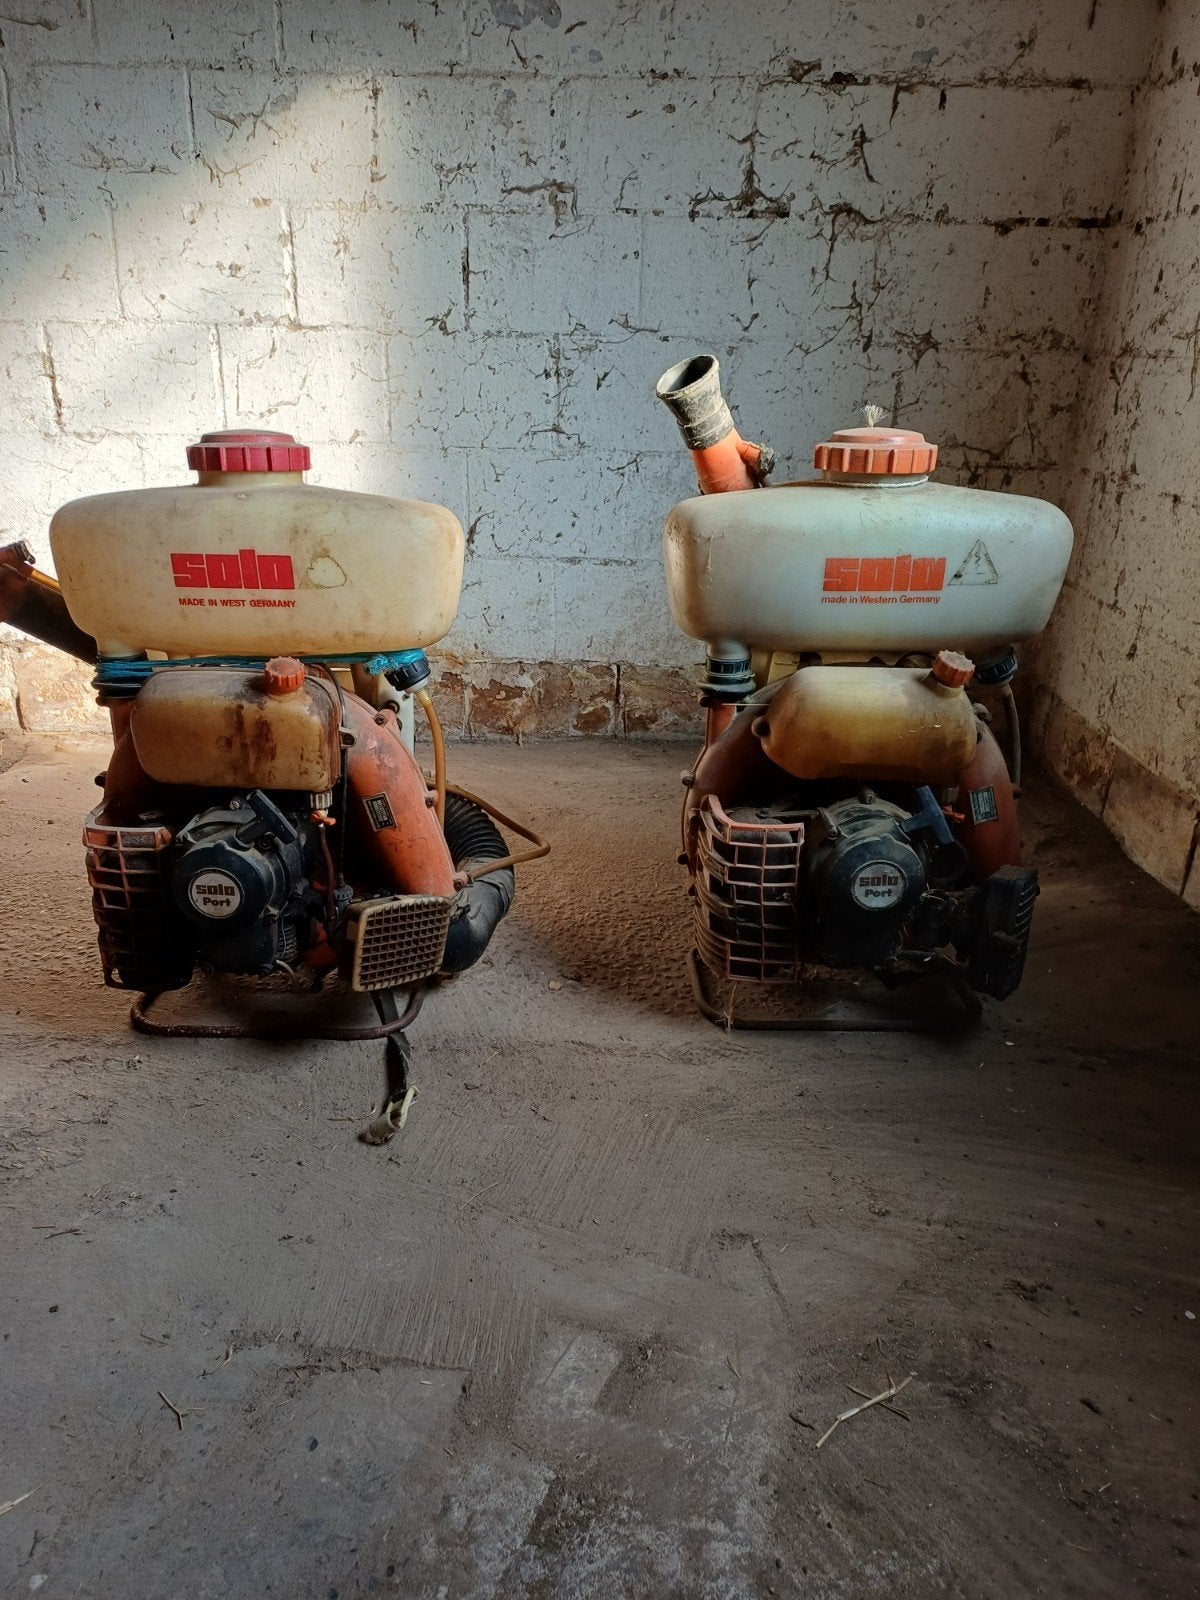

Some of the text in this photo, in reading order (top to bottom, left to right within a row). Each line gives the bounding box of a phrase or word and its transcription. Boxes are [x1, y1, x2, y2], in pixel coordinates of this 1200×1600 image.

[170, 549, 295, 590] solo
[178, 598, 296, 608] MADE IN WEST GERMANY
[821, 595, 941, 605] made in Western Germany
[195, 884, 235, 896] solo
[864, 888, 893, 898] Port
[202, 897, 231, 907] Port
